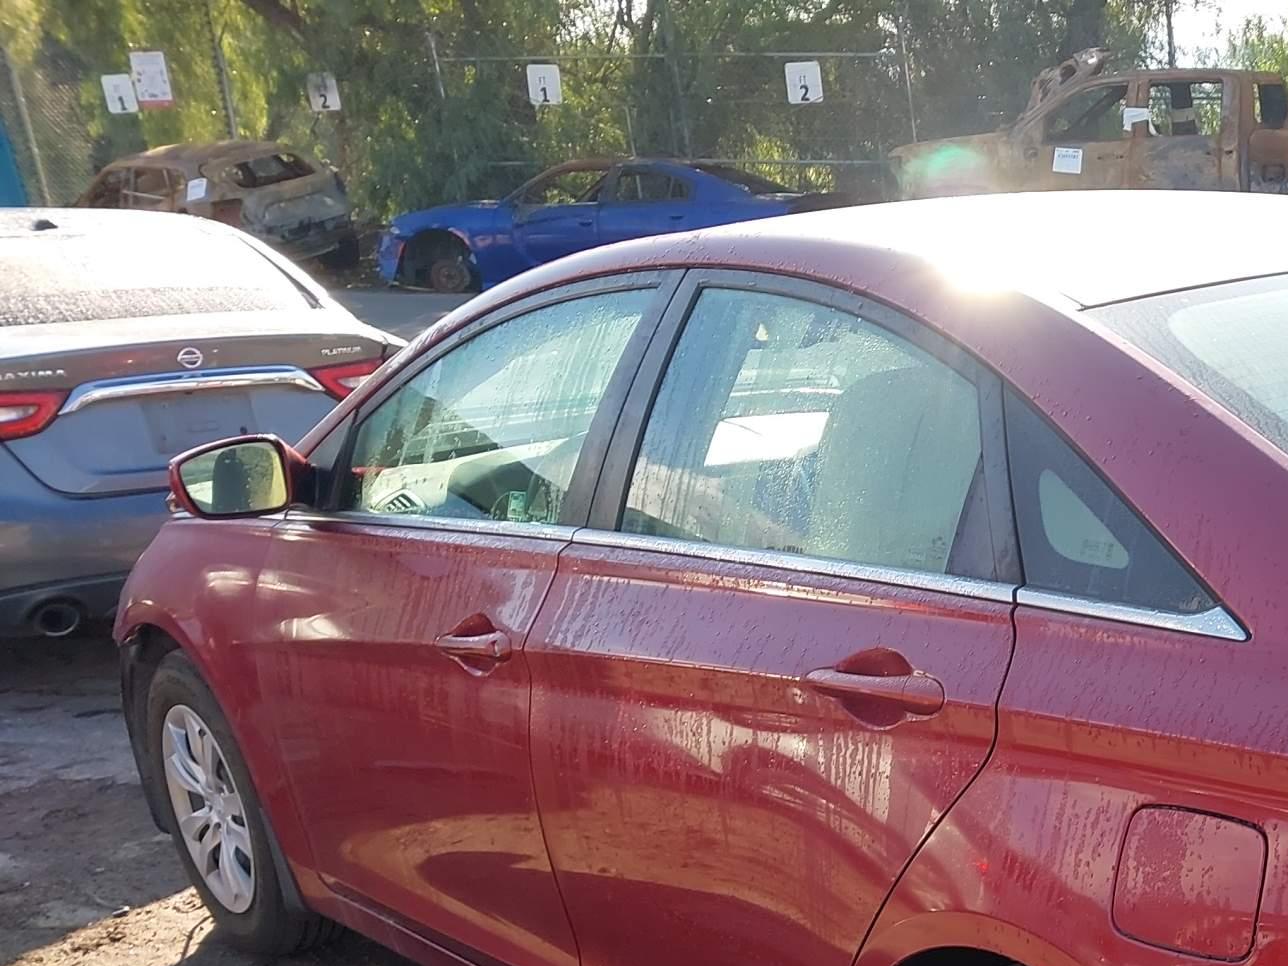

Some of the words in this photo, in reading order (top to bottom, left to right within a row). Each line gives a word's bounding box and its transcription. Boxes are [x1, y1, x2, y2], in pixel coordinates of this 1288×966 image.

[319, 94, 330, 109] 2
[540, 86, 550, 103] 1
[800, 85, 810, 102] 2
[117, 95, 128, 111] 1
[0, 369, 67, 380] AXIMA
